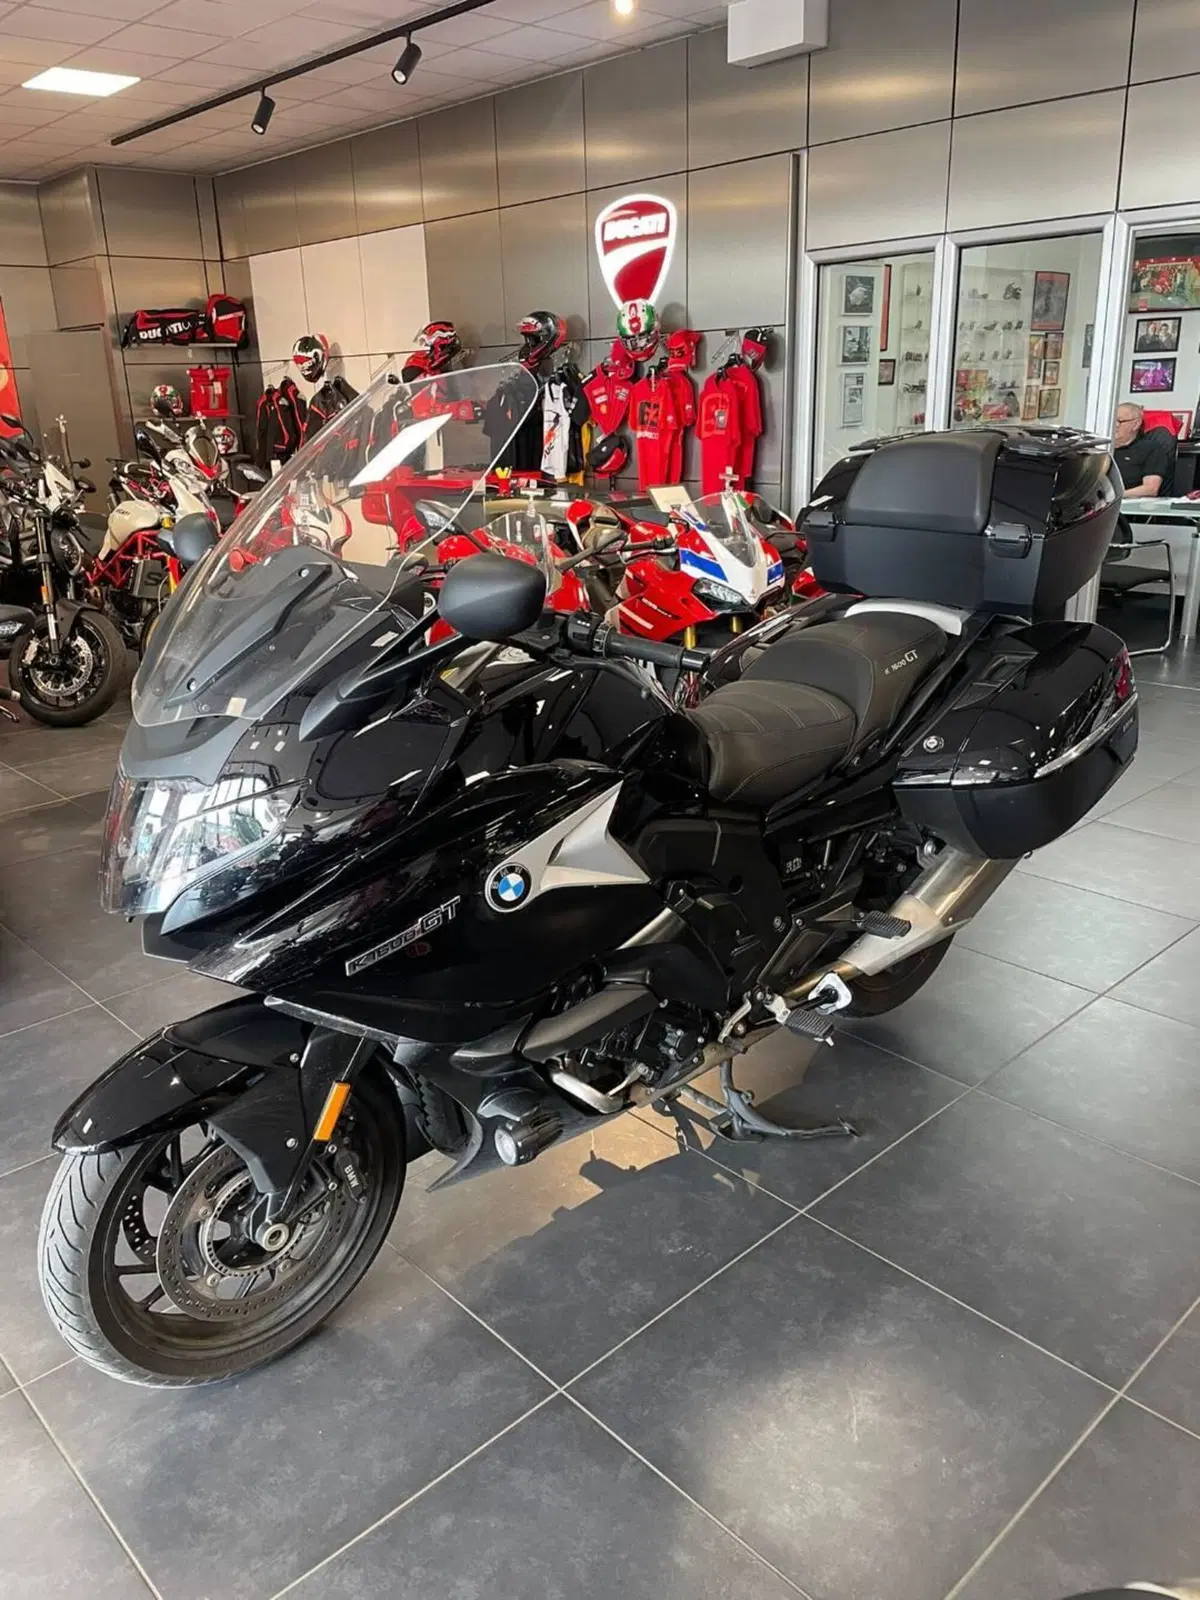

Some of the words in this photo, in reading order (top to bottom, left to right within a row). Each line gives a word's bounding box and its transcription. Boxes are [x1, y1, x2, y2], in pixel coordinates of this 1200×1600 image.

[904, 649, 918, 663] GT
[490, 865, 523, 890] BMW
[344, 1164, 360, 1188] BMW
